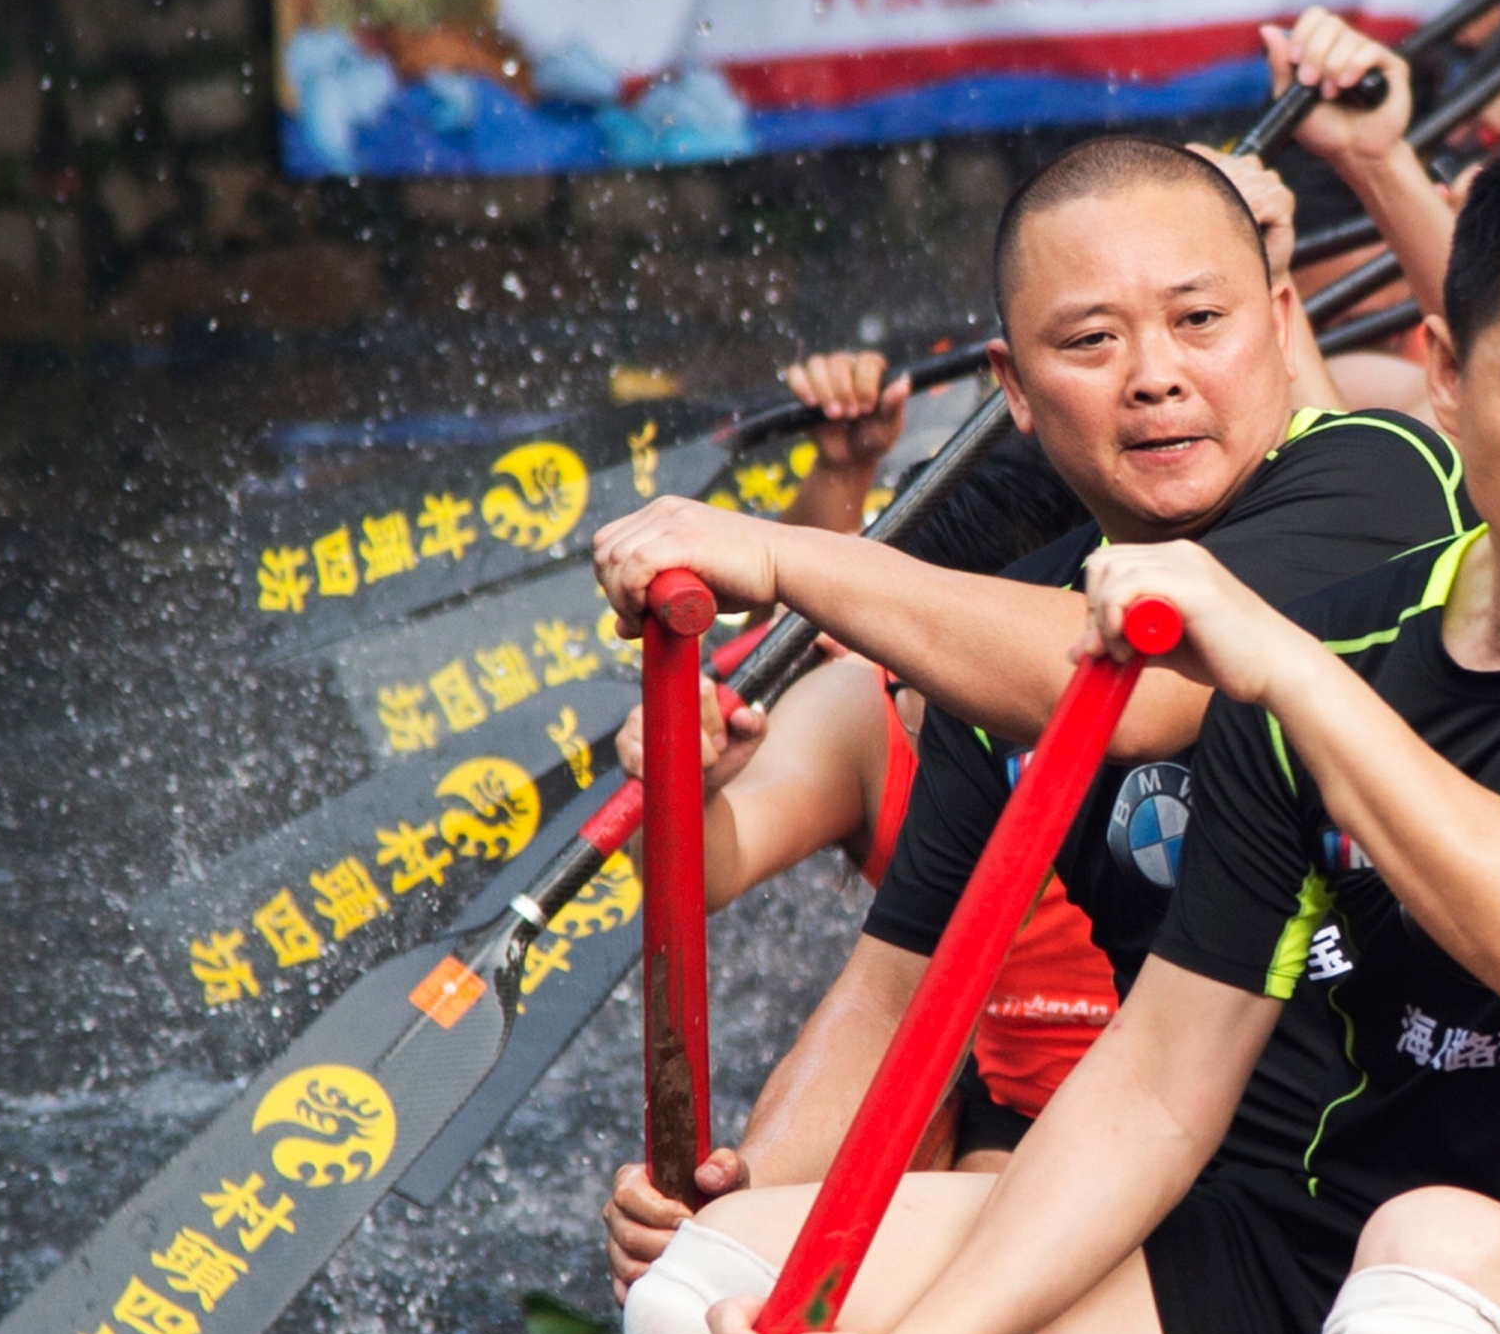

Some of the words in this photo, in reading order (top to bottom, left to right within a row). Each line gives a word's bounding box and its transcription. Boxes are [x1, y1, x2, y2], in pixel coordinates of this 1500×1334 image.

[257, 492, 477, 611] 村頭四坊
[190, 819, 453, 1004] 村頭四坊
